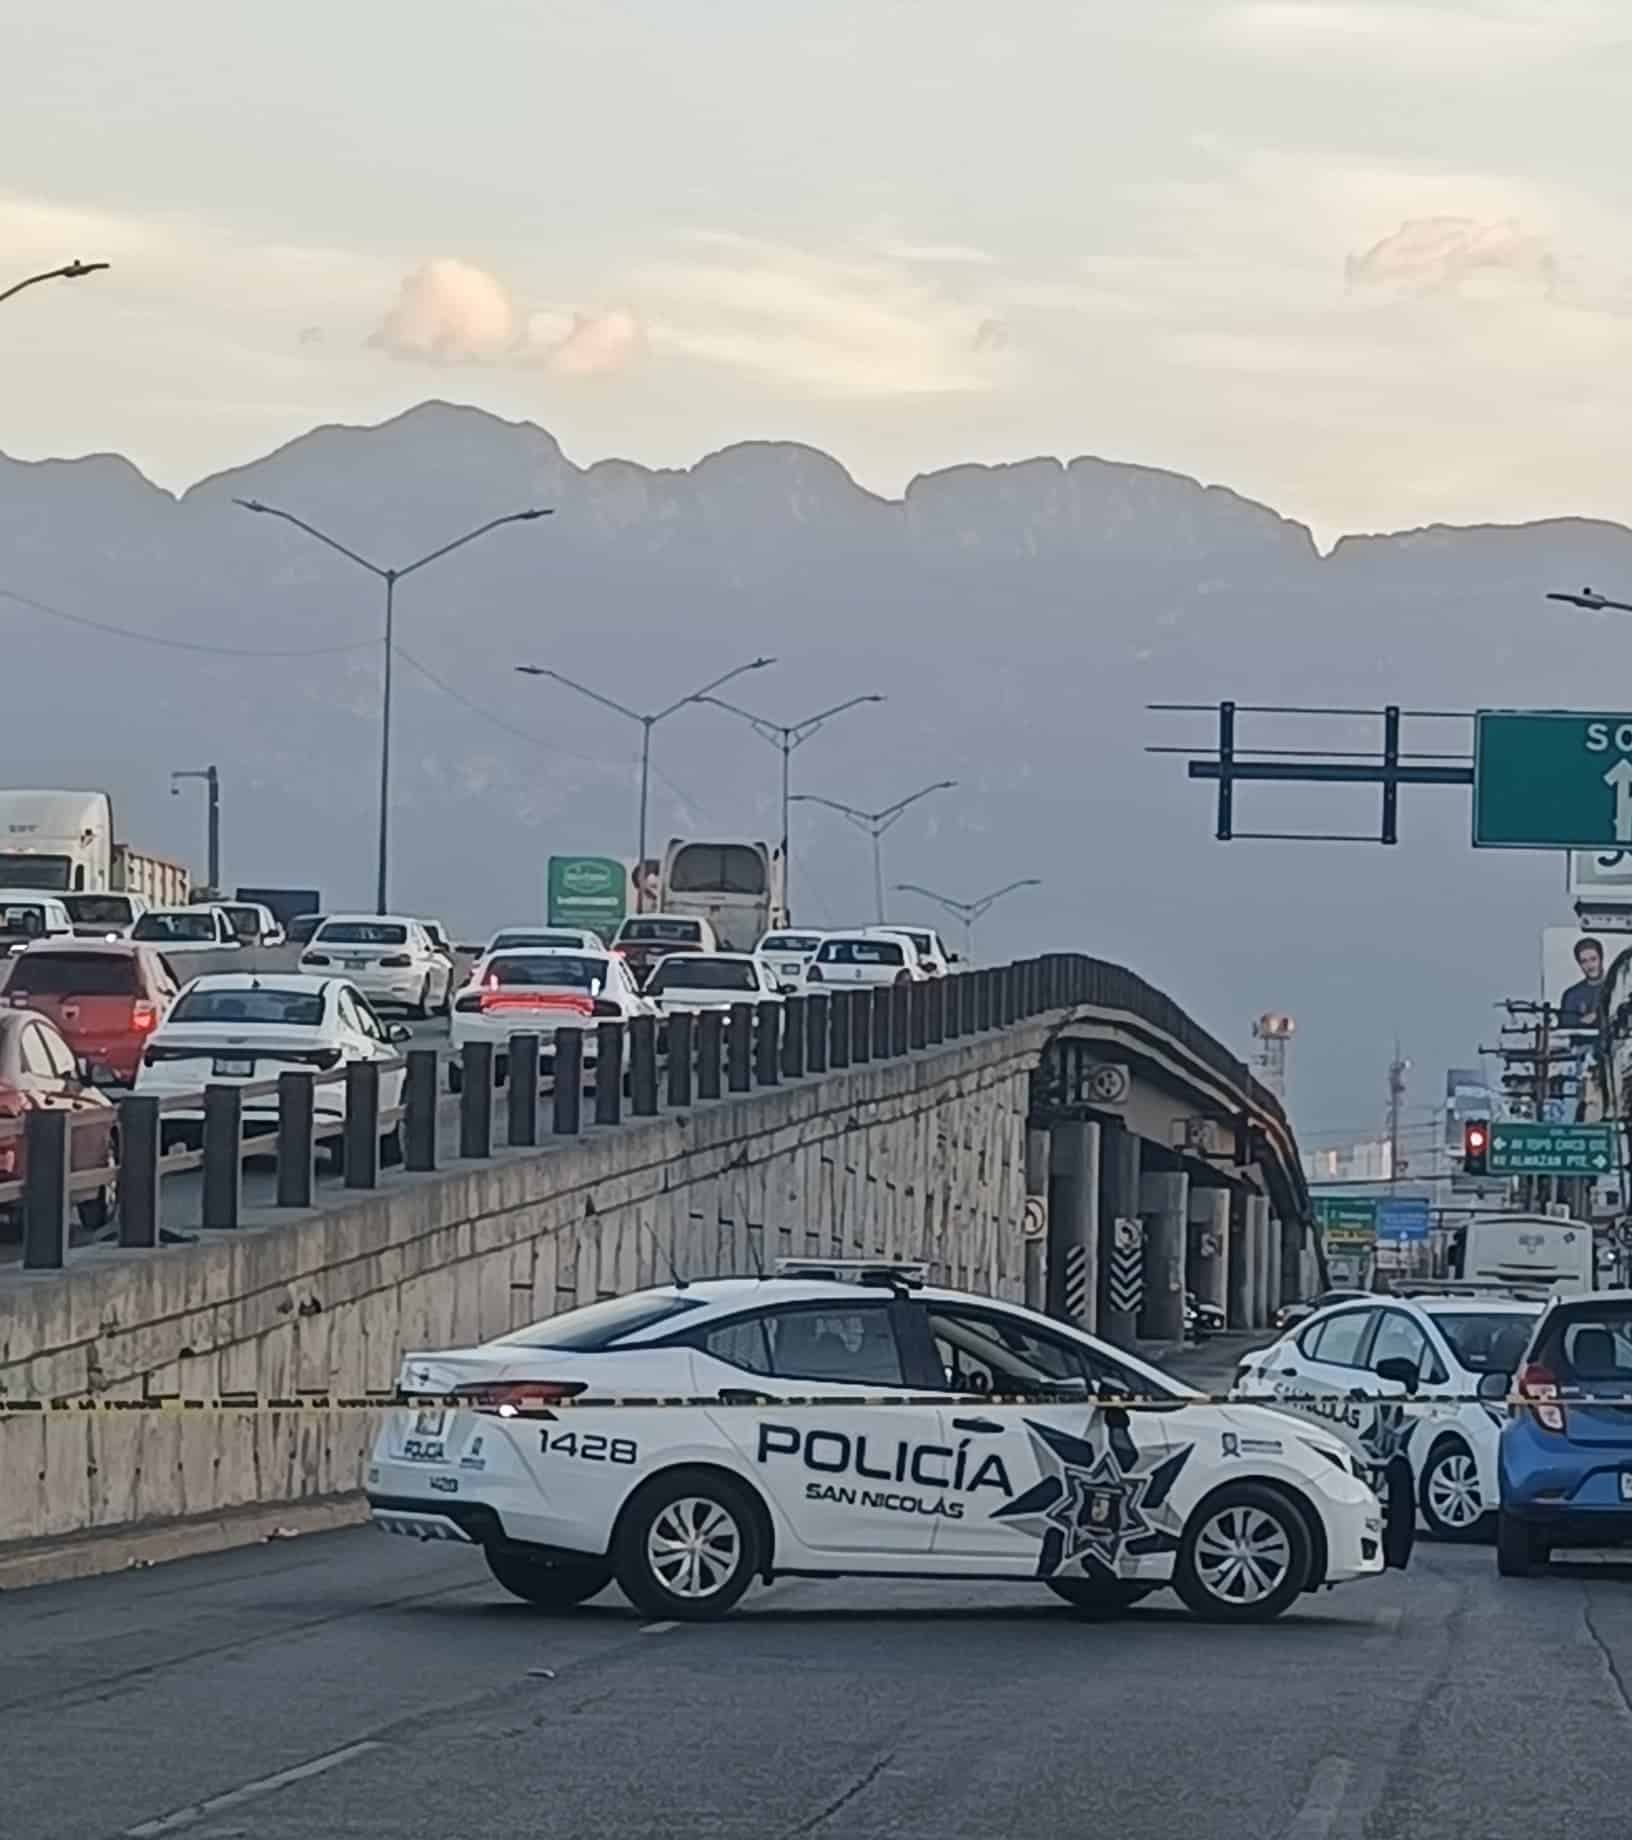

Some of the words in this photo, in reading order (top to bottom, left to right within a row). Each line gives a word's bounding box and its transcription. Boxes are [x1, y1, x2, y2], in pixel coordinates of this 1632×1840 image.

[538, 1428, 638, 1465] 1428
[757, 1421, 1014, 1497] POLICÍA
[805, 1483, 857, 1505] SAN
[860, 1490, 965, 1519] NICOLÁS
